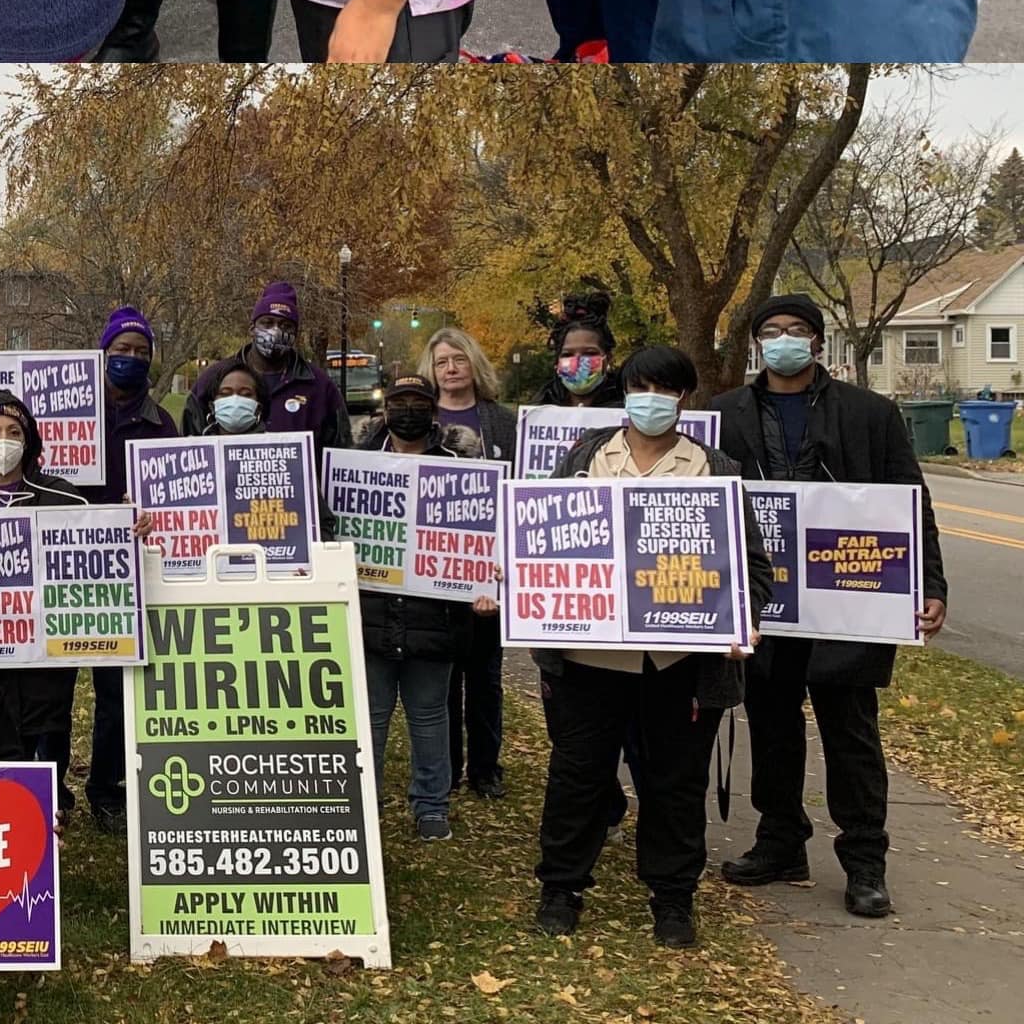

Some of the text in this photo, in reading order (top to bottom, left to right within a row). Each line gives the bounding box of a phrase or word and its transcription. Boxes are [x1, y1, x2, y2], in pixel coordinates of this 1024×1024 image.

[23, 361, 89, 392] DON'T CALL
[31, 393, 46, 416] US
[50, 385, 94, 413] HEROES
[68, 421, 96, 441] PAY
[49, 444, 97, 467] ZERO!
[228, 447, 297, 461] HEALTHCARE
[141, 448, 209, 481] DON'T CALL
[239, 460, 287, 473] HEROES
[237, 472, 291, 486] DESERVE
[332, 467, 410, 489] HEALTHCARE
[419, 472, 491, 499] DON'T CALL
[149, 472, 214, 505] US HEROES
[235, 486, 295, 500] SUPPORT!
[250, 499, 284, 513] SAFE
[333, 486, 407, 519] HEROES
[516, 489, 604, 527] DON'T CALL
[629, 492, 720, 507] HEALTHCARE
[150, 509, 218, 532] HEN PAY
[233, 512, 299, 526] STAFFING
[426, 497, 495, 525] US HEROES
[643, 507, 706, 523] HEROES
[42, 527, 131, 546] HEALTHCARE
[247, 526, 286, 540] NOW!
[526, 518, 610, 556] US HEROES
[640, 523, 711, 539] DESERVE
[416, 529, 496, 557] THEN PAY
[637, 538, 716, 554] SUPPORT!
[838, 536, 878, 549] FAIR
[355, 543, 406, 567] PPORT
[656, 554, 702, 571] SAFE
[808, 546, 907, 562] CONTRACT
[45, 549, 130, 580] HEROES
[163, 560, 202, 568] 1199SEIU
[357, 567, 389, 578] 9SEIU
[414, 554, 494, 584] US ZERO!
[834, 560, 883, 574] NOW!
[433, 580, 473, 591] 1199SEIU
[516, 563, 615, 589] THEN PAY
[635, 570, 721, 589] STAFFING
[835, 579, 882, 590] 1199SEIU
[1, 591, 34, 615] PAY
[43, 582, 135, 608] DESERVE
[652, 587, 703, 604] NOW!
[517, 593, 616, 622] US ZERO!
[45, 612, 135, 636] SUPPORT
[541, 623, 591, 632] 1199SEIU
[643, 611, 718, 625] 1199SEIU
[147, 605, 333, 656] WE'RE
[63, 640, 118, 651] 1199SEIU
[144, 659, 345, 711] HIRING
[145, 715, 347, 737] CNAs LPNs RNs
[208, 754, 348, 775] ROCHESTER
[210, 779, 348, 795] COMMUNITY
[211, 805, 351, 814] NURSING & REHABILITATION CENTER
[148, 828, 358, 844] ROCHESTERHEALTHCARE.COM
[149, 847, 360, 876] 585.482.3500
[173, 891, 339, 914] APPLY WITHIN
[160, 919, 357, 935] IMMEDIATE INTERVIEW
